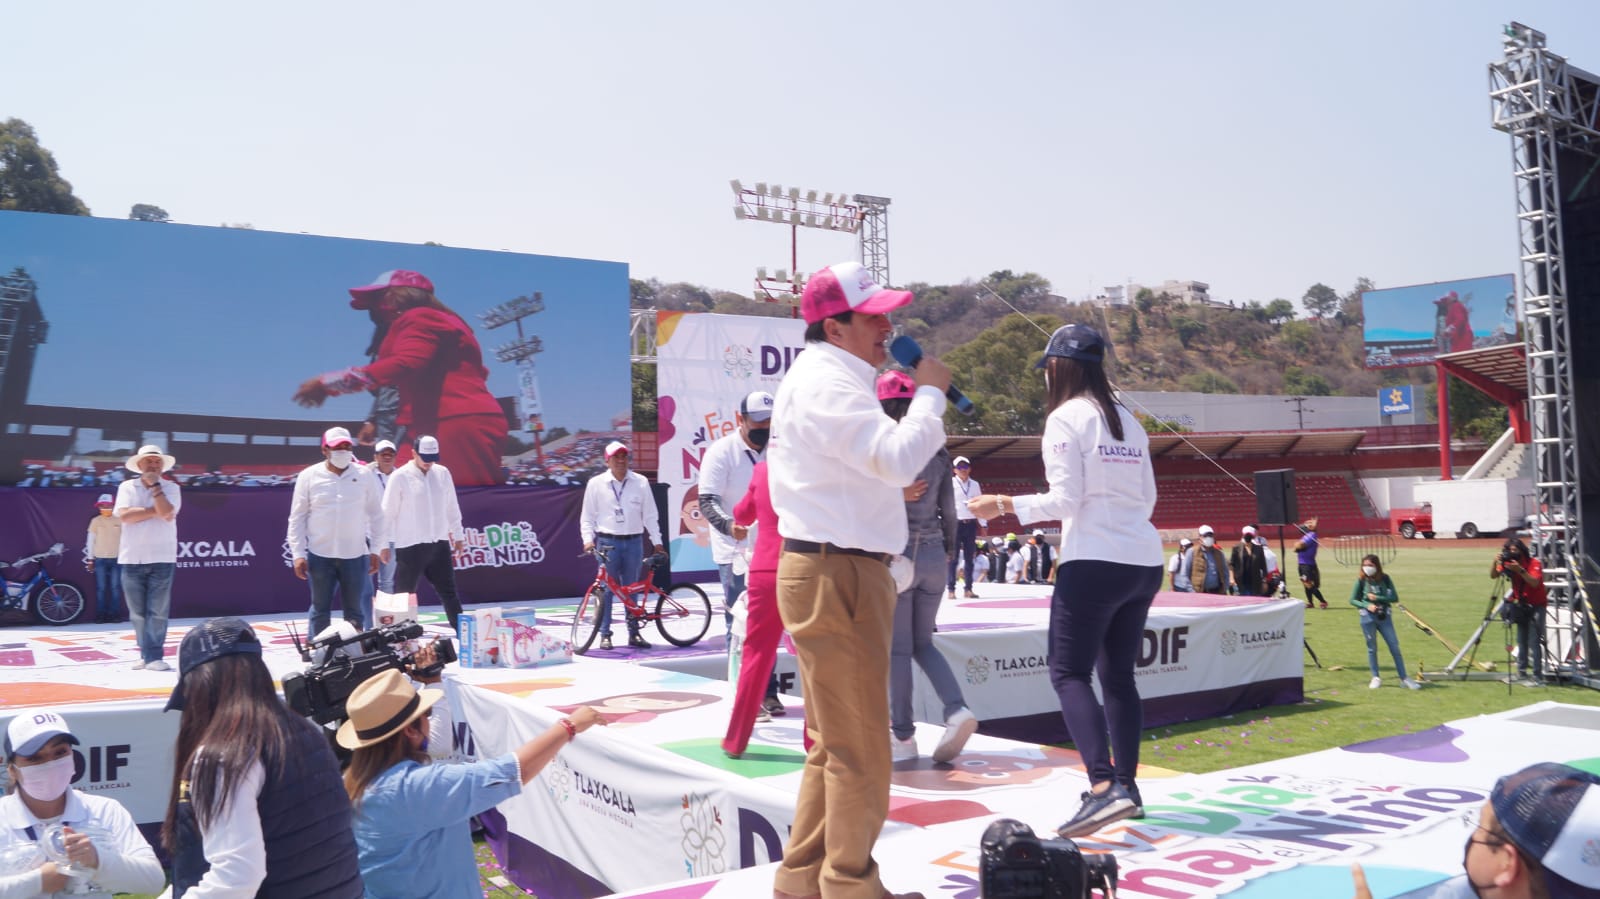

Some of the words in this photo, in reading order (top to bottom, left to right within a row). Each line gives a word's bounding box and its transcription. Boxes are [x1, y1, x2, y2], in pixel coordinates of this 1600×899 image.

[1098, 446, 1142, 458] TLAXCALA
[487, 525, 521, 547] Día
[178, 541, 256, 558] XCALA
[494, 540, 542, 565] Niño
[1240, 630, 1286, 645] TLAXCALA
[573, 771, 637, 817] TLAXCALA
